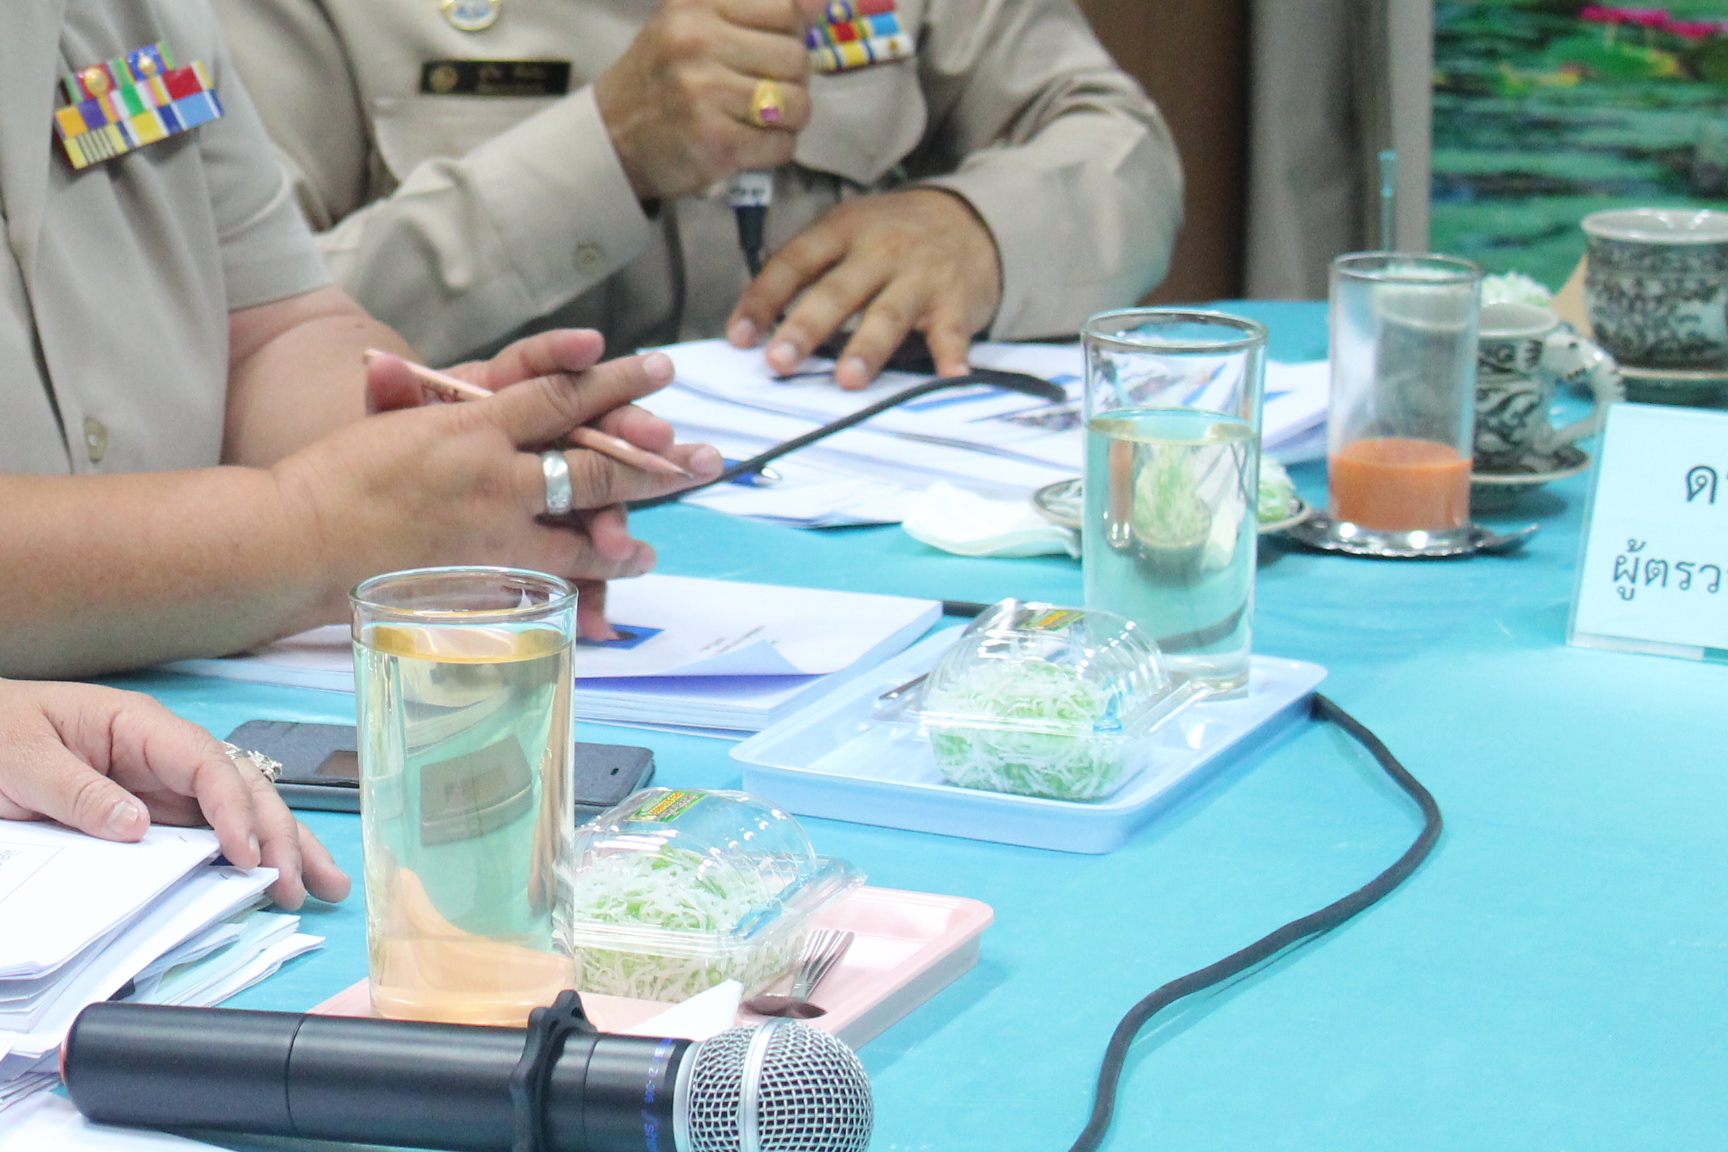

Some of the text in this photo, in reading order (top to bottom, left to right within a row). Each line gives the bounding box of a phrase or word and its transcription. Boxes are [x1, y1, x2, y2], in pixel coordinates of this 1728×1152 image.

[1685, 465, 1728, 505] ด
[1612, 538, 1728, 601] ผู้ตรว
